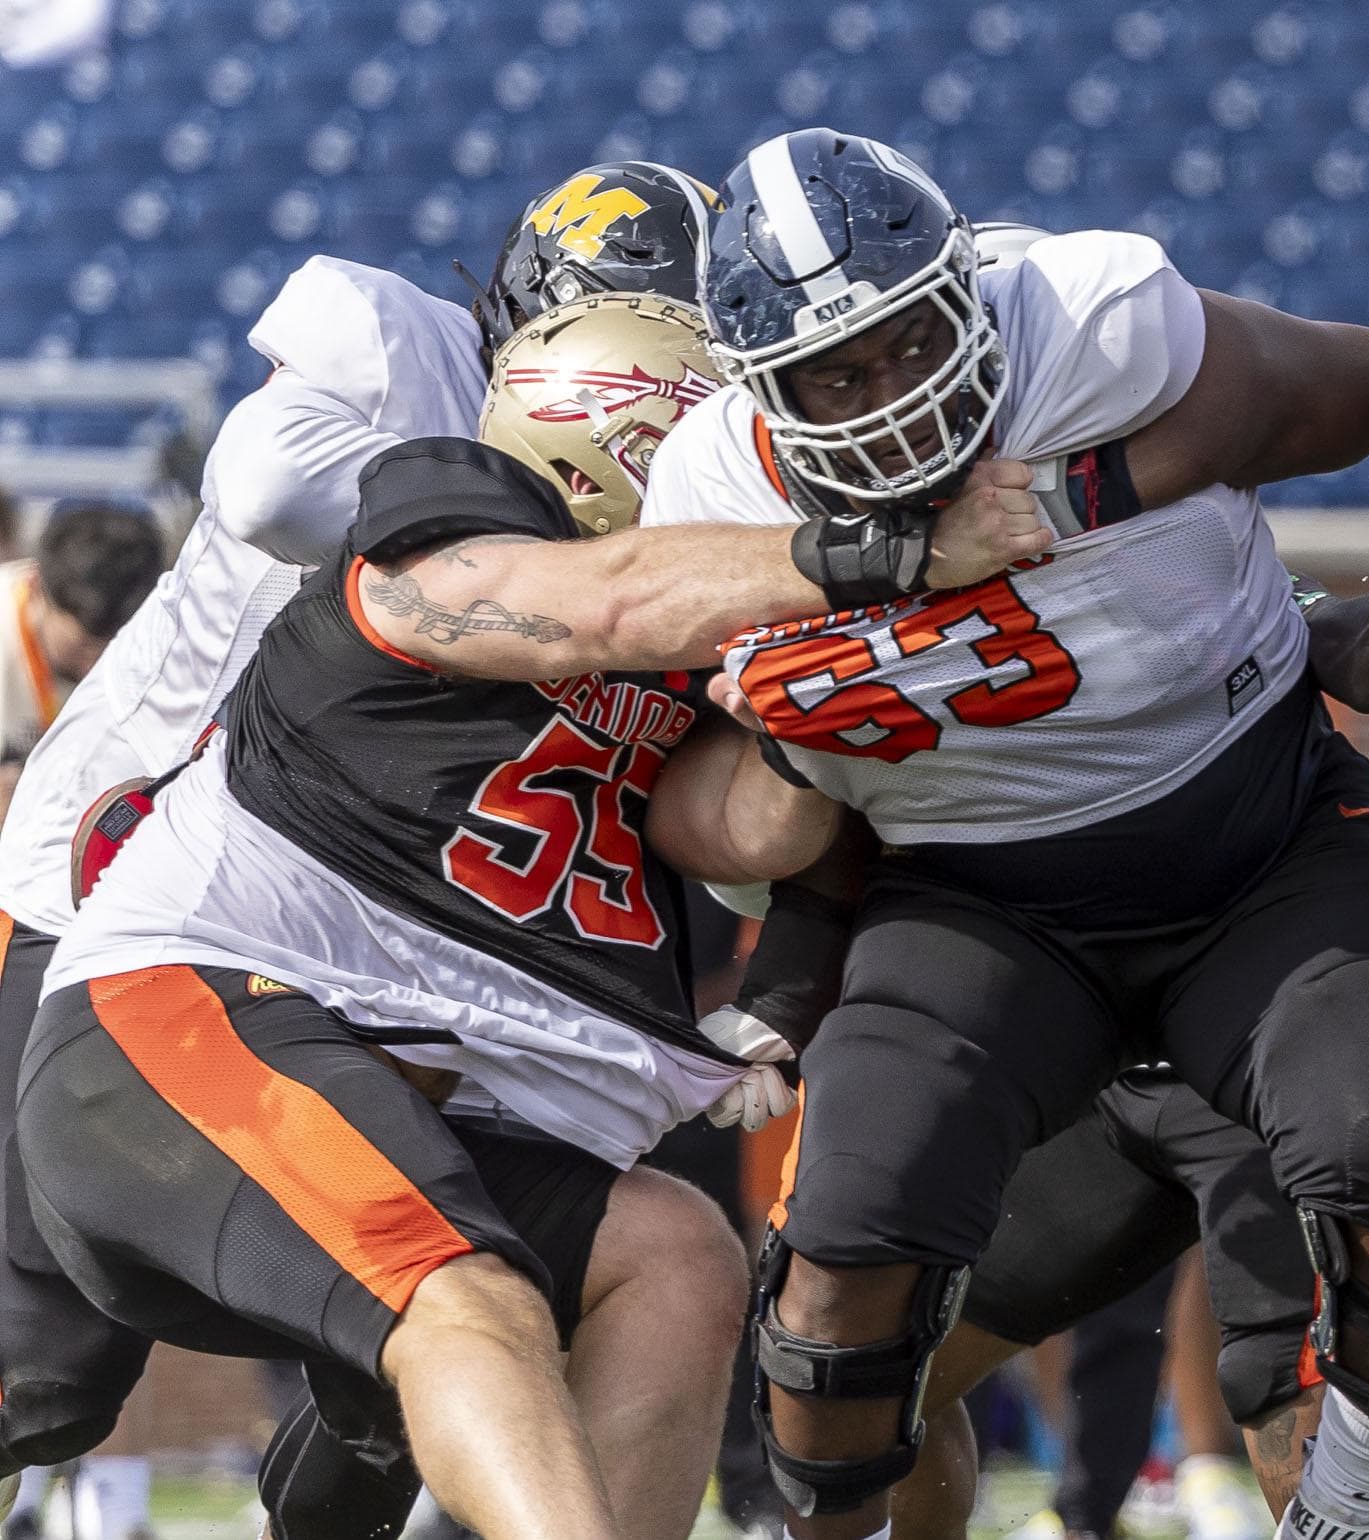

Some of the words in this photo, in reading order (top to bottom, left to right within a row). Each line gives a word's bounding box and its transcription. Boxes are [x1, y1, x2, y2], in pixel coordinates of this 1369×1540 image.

[521, 173, 652, 262] M
[738, 572, 1082, 764] 63
[1231, 664, 1257, 691] 3XL
[440, 712, 668, 951] 55
